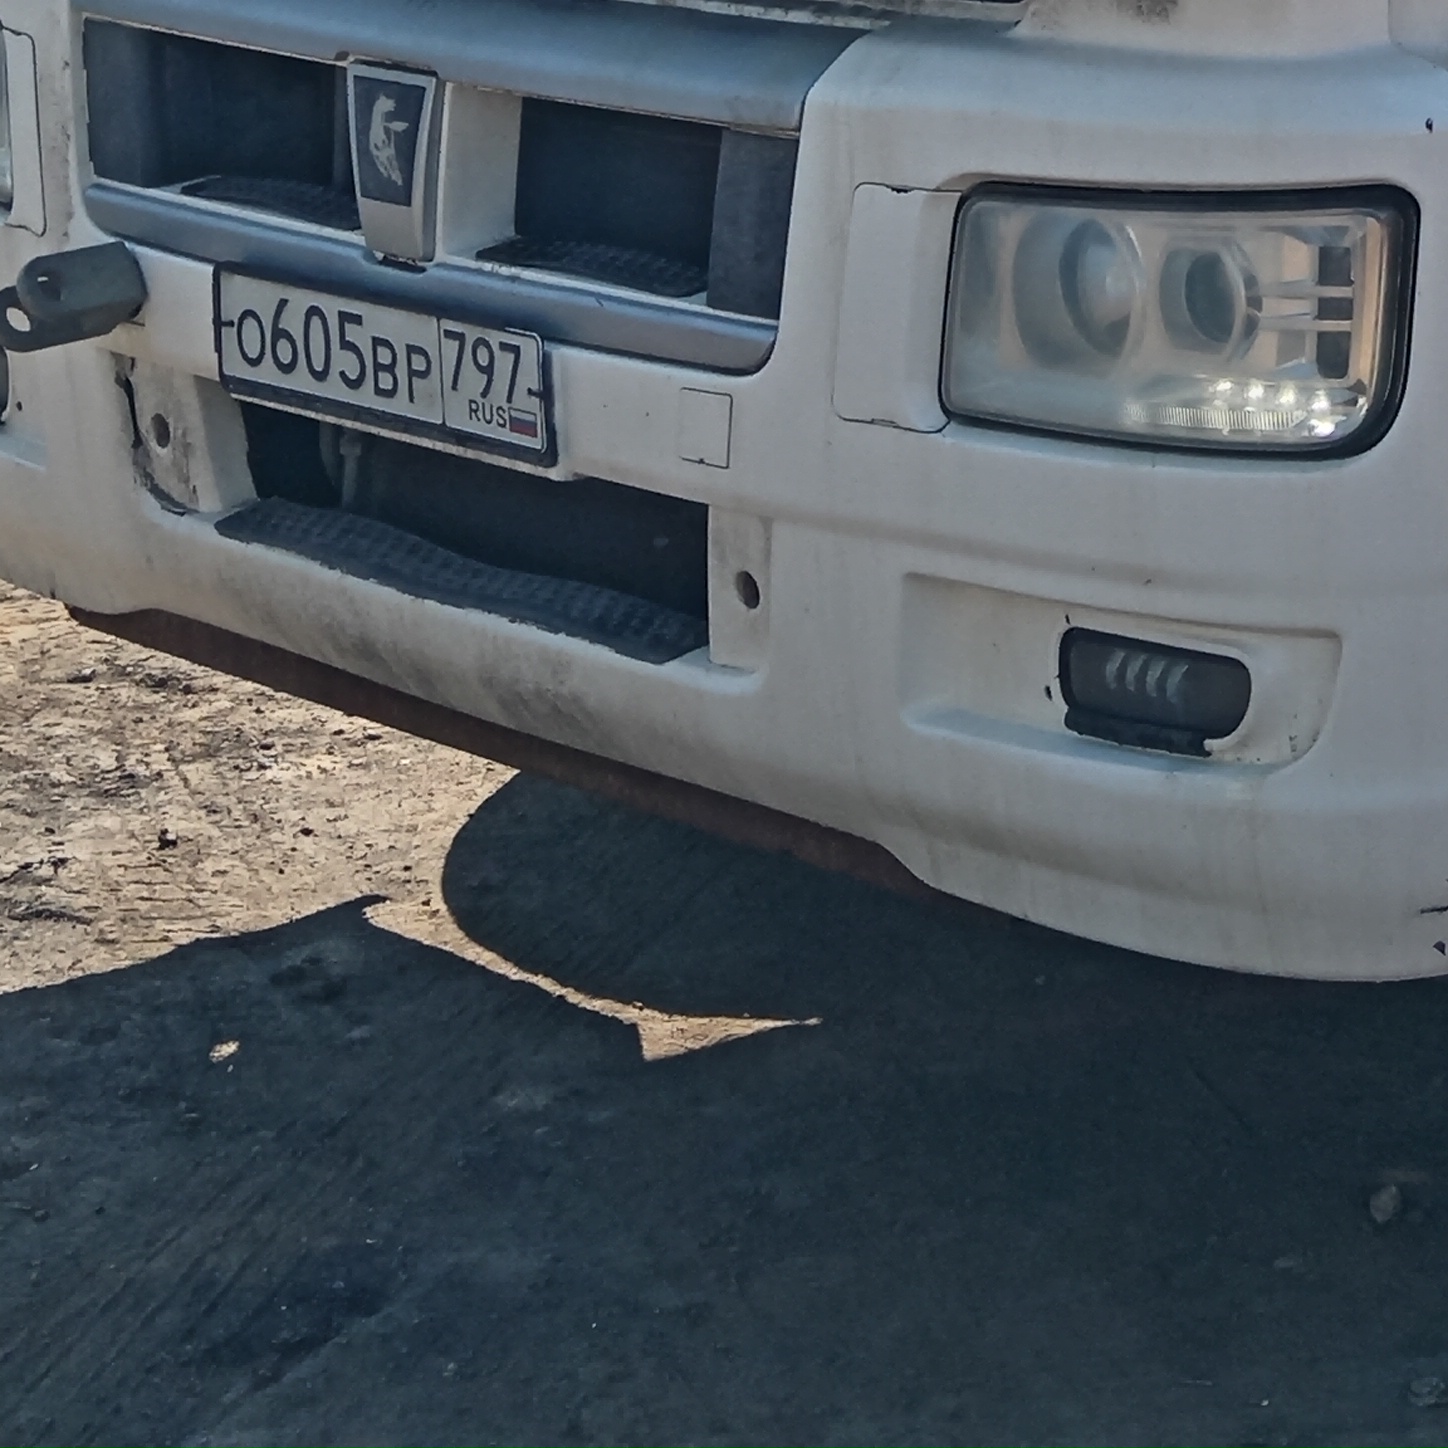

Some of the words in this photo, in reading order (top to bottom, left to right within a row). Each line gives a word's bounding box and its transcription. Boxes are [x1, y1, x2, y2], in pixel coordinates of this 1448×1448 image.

[236, 297, 433, 404] О605ВР
[442, 328, 522, 405] 797
[467, 399, 508, 429] RUS
